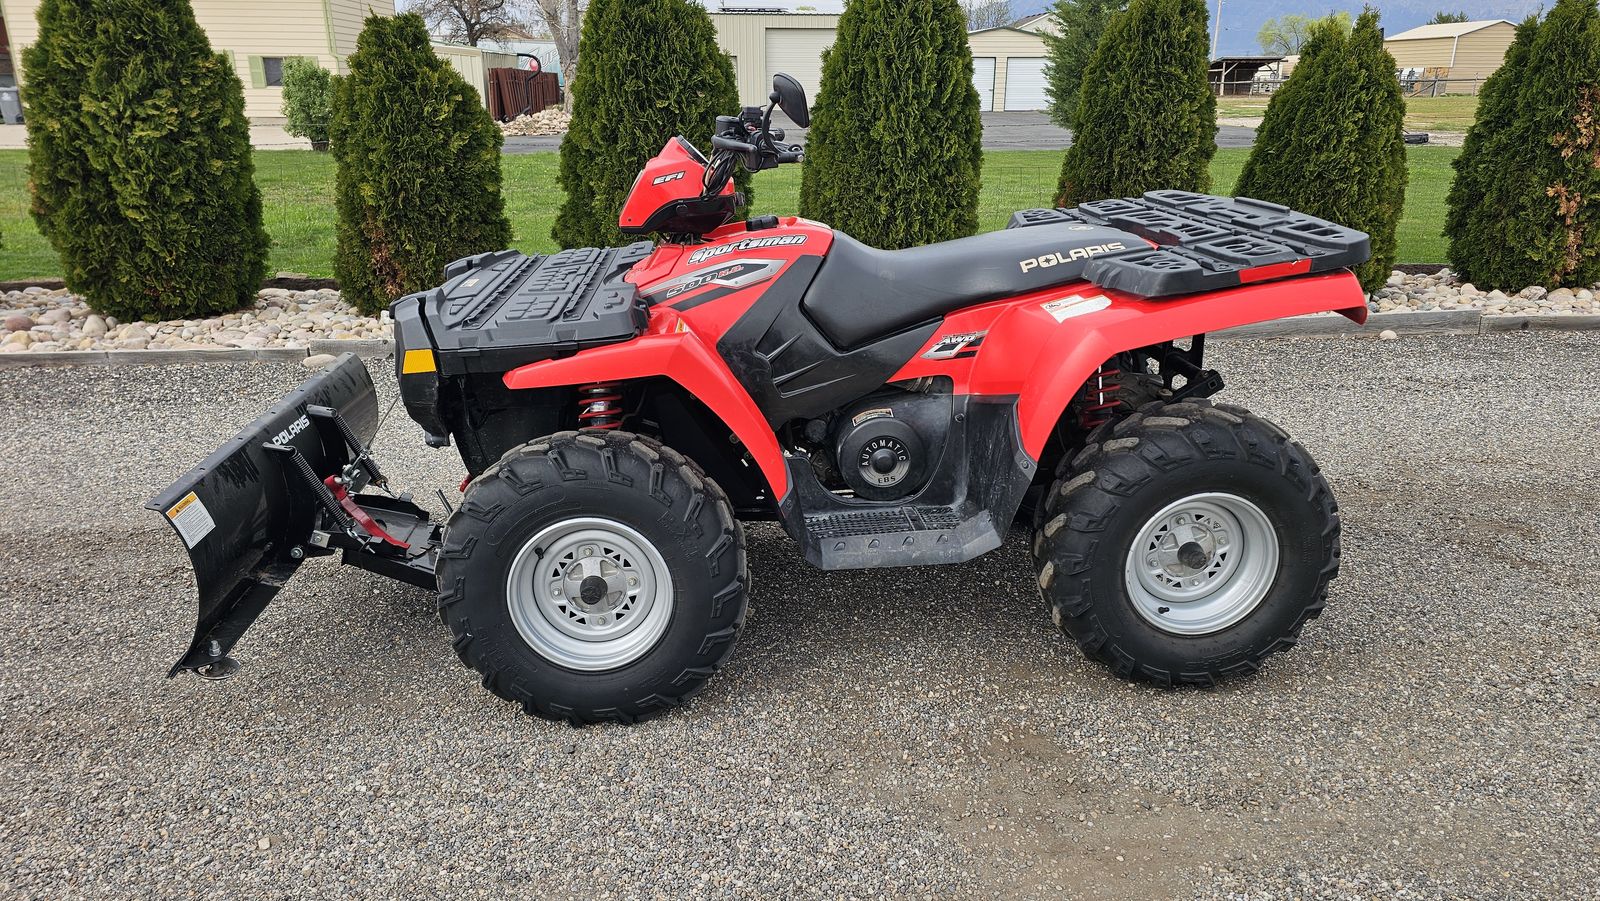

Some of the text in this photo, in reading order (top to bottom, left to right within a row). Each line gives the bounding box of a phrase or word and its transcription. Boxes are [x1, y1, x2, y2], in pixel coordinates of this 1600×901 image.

[652, 171, 685, 186] EFI
[687, 234, 808, 265] Sportsman
[1020, 242, 1126, 273] POLARIS
[667, 273, 718, 298] 500
[272, 414, 310, 446] POLARIS
[862, 440, 907, 466] AUTOMATIC
[878, 476, 896, 484] EBS
